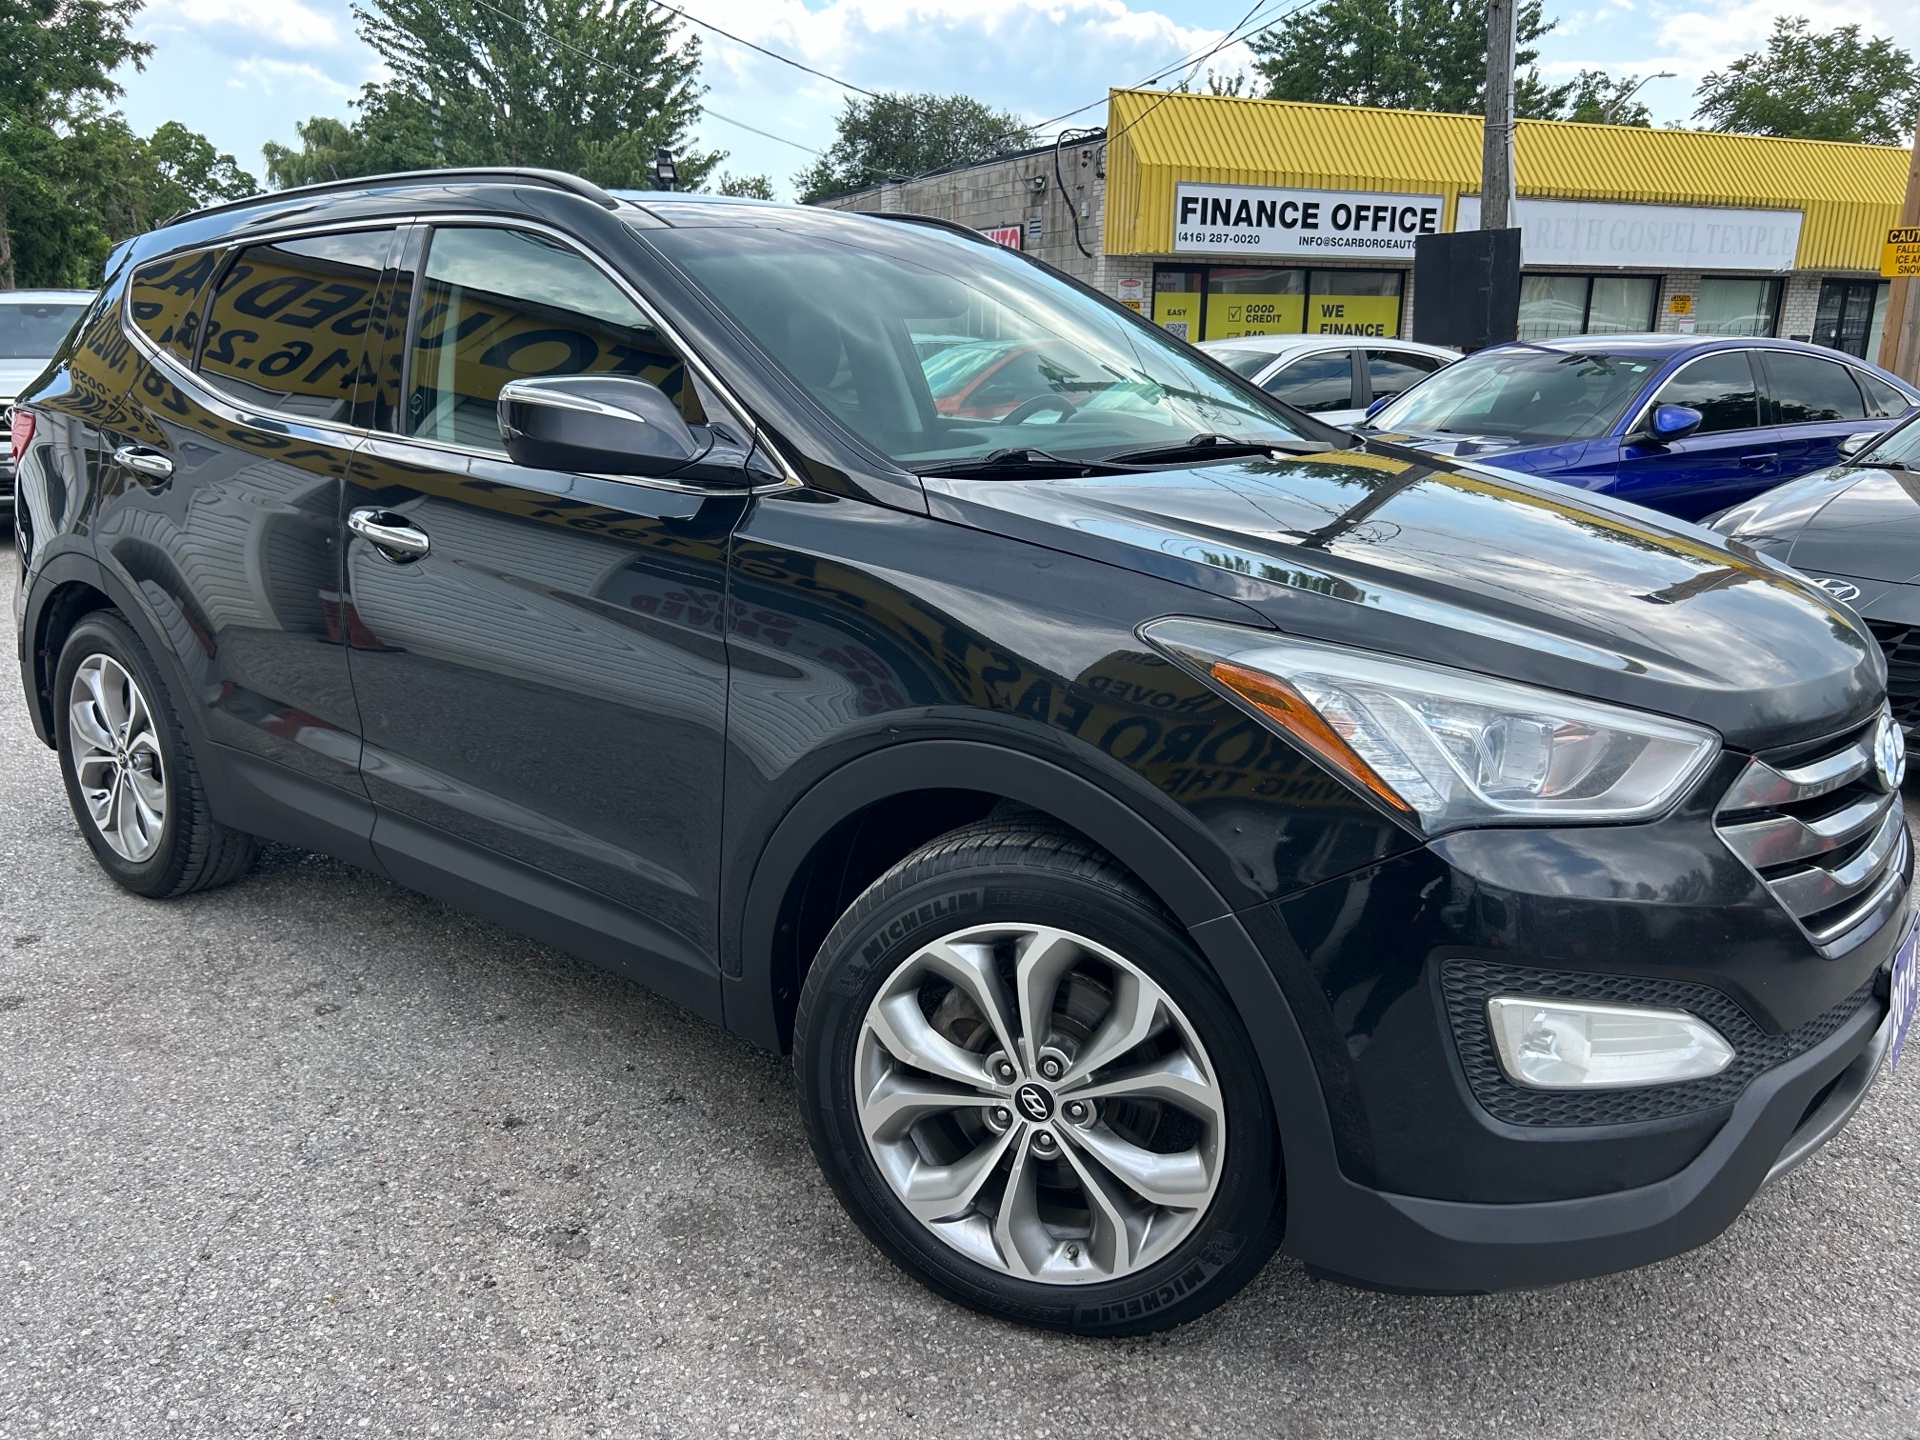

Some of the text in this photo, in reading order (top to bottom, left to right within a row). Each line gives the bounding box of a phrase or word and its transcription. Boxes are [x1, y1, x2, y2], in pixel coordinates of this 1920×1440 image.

[1180, 196, 1437, 234] FINANCE OFFICE
[1178, 232, 1261, 244] (416) 287-0020
[1609, 220, 1700, 253] GOSPEL
[1706, 223, 1795, 256] TEMPLE
[1895, 256, 1909, 264] ICE
[1246, 304, 1275, 313] GOOD
[1321, 304, 1345, 318] WE
[1245, 314, 1282, 324] CREDIT
[1320, 323, 1384, 337] FINANCE
[861, 891, 979, 965] MICHELIN
[1080, 1263, 1208, 1325] MICHELIN
